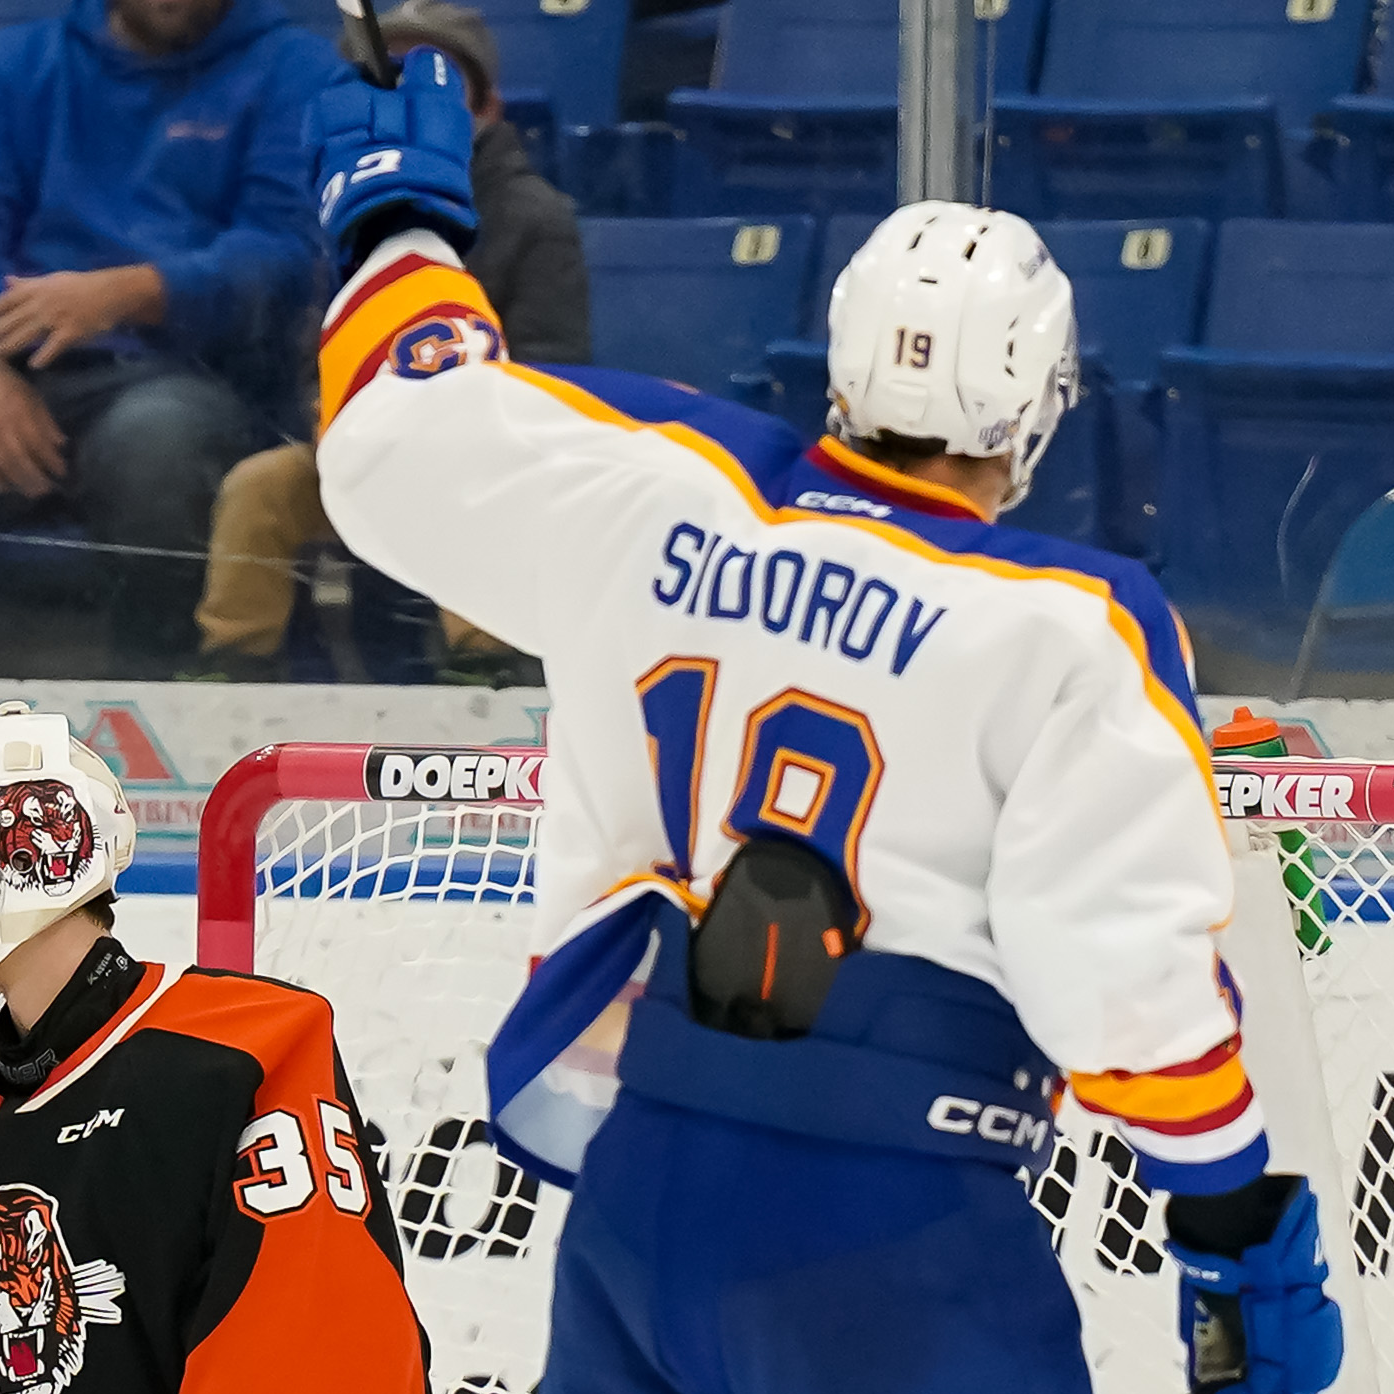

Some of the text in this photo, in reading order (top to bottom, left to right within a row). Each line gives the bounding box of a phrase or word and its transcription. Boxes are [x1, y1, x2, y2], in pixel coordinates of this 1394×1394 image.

[893, 326, 935, 370] 19
[652, 522, 948, 678] SIDOROV
[380, 755, 546, 801] DOEPK
[1214, 773, 1358, 821] EPKER
[926, 1095, 1052, 1153] CCM
[236, 1094, 373, 1226] 35
